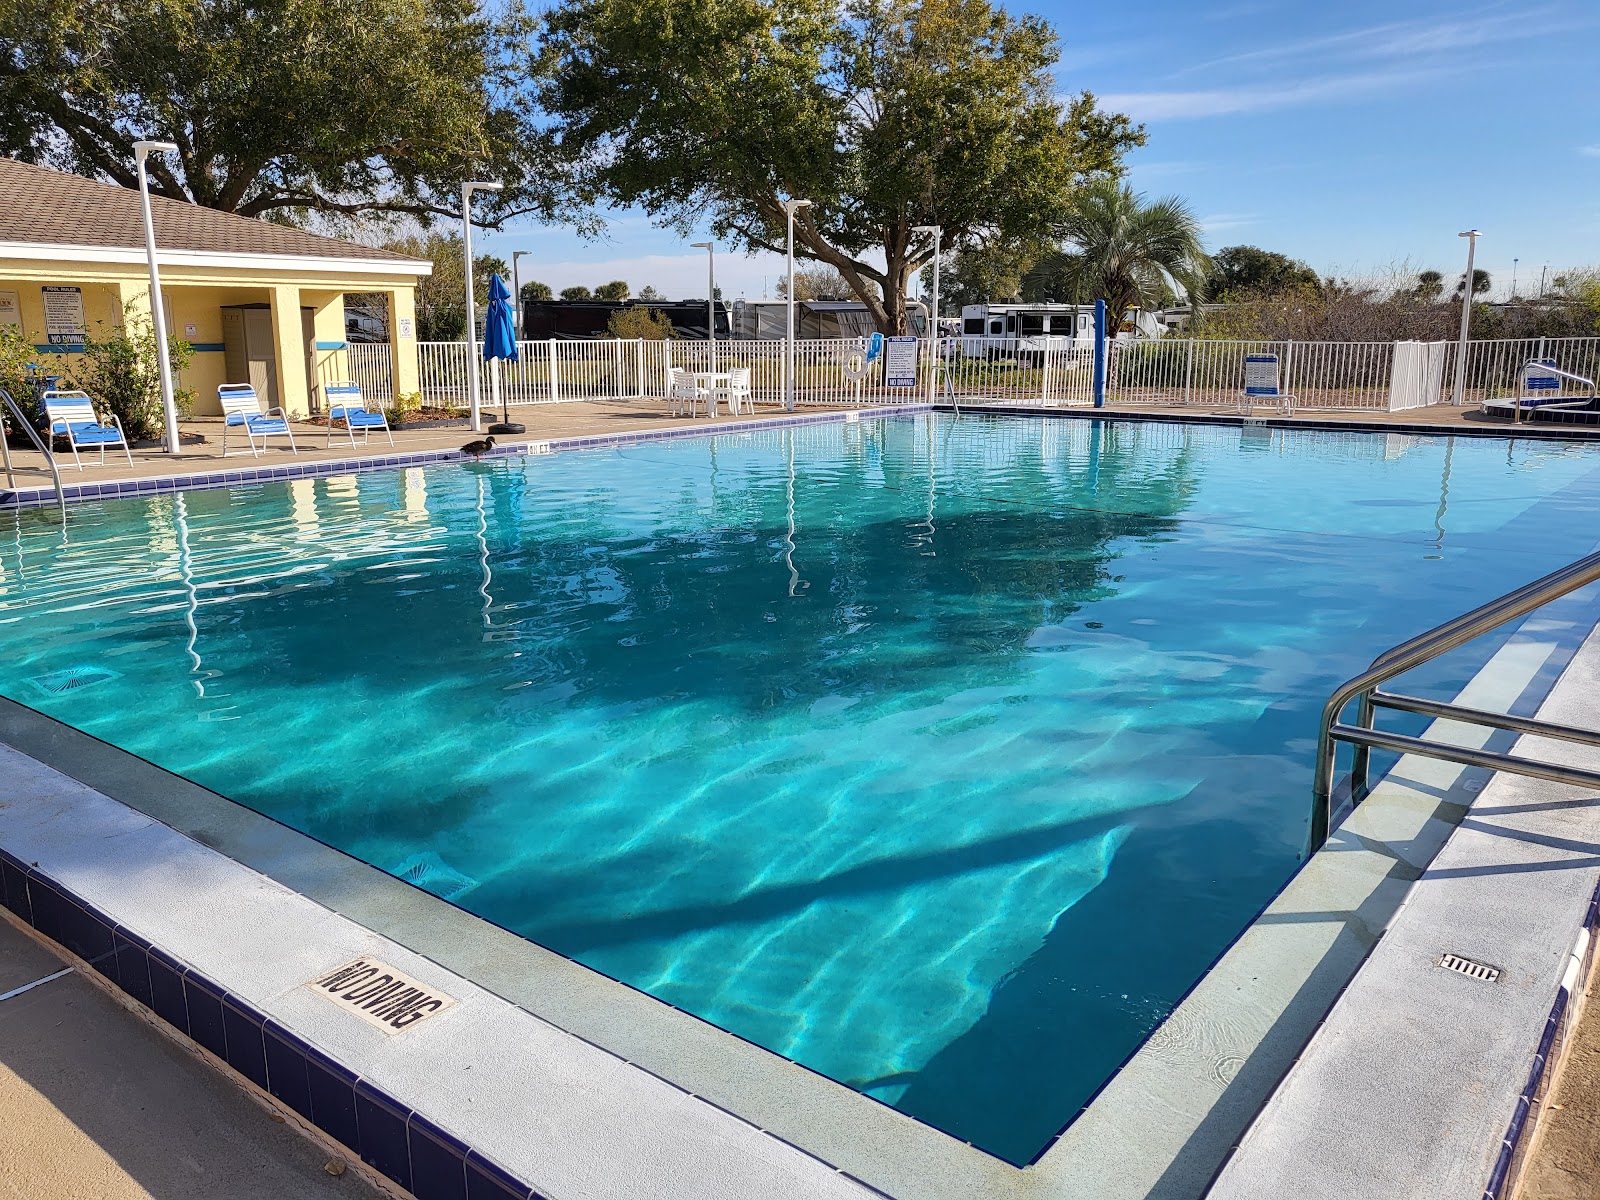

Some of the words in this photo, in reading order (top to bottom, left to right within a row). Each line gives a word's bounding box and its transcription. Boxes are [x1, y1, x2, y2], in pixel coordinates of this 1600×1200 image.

[51, 335, 61, 343] NO
[62, 335, 85, 343] DIVING
[315, 961, 380, 993] NO
[340, 974, 443, 1029] DIVING
